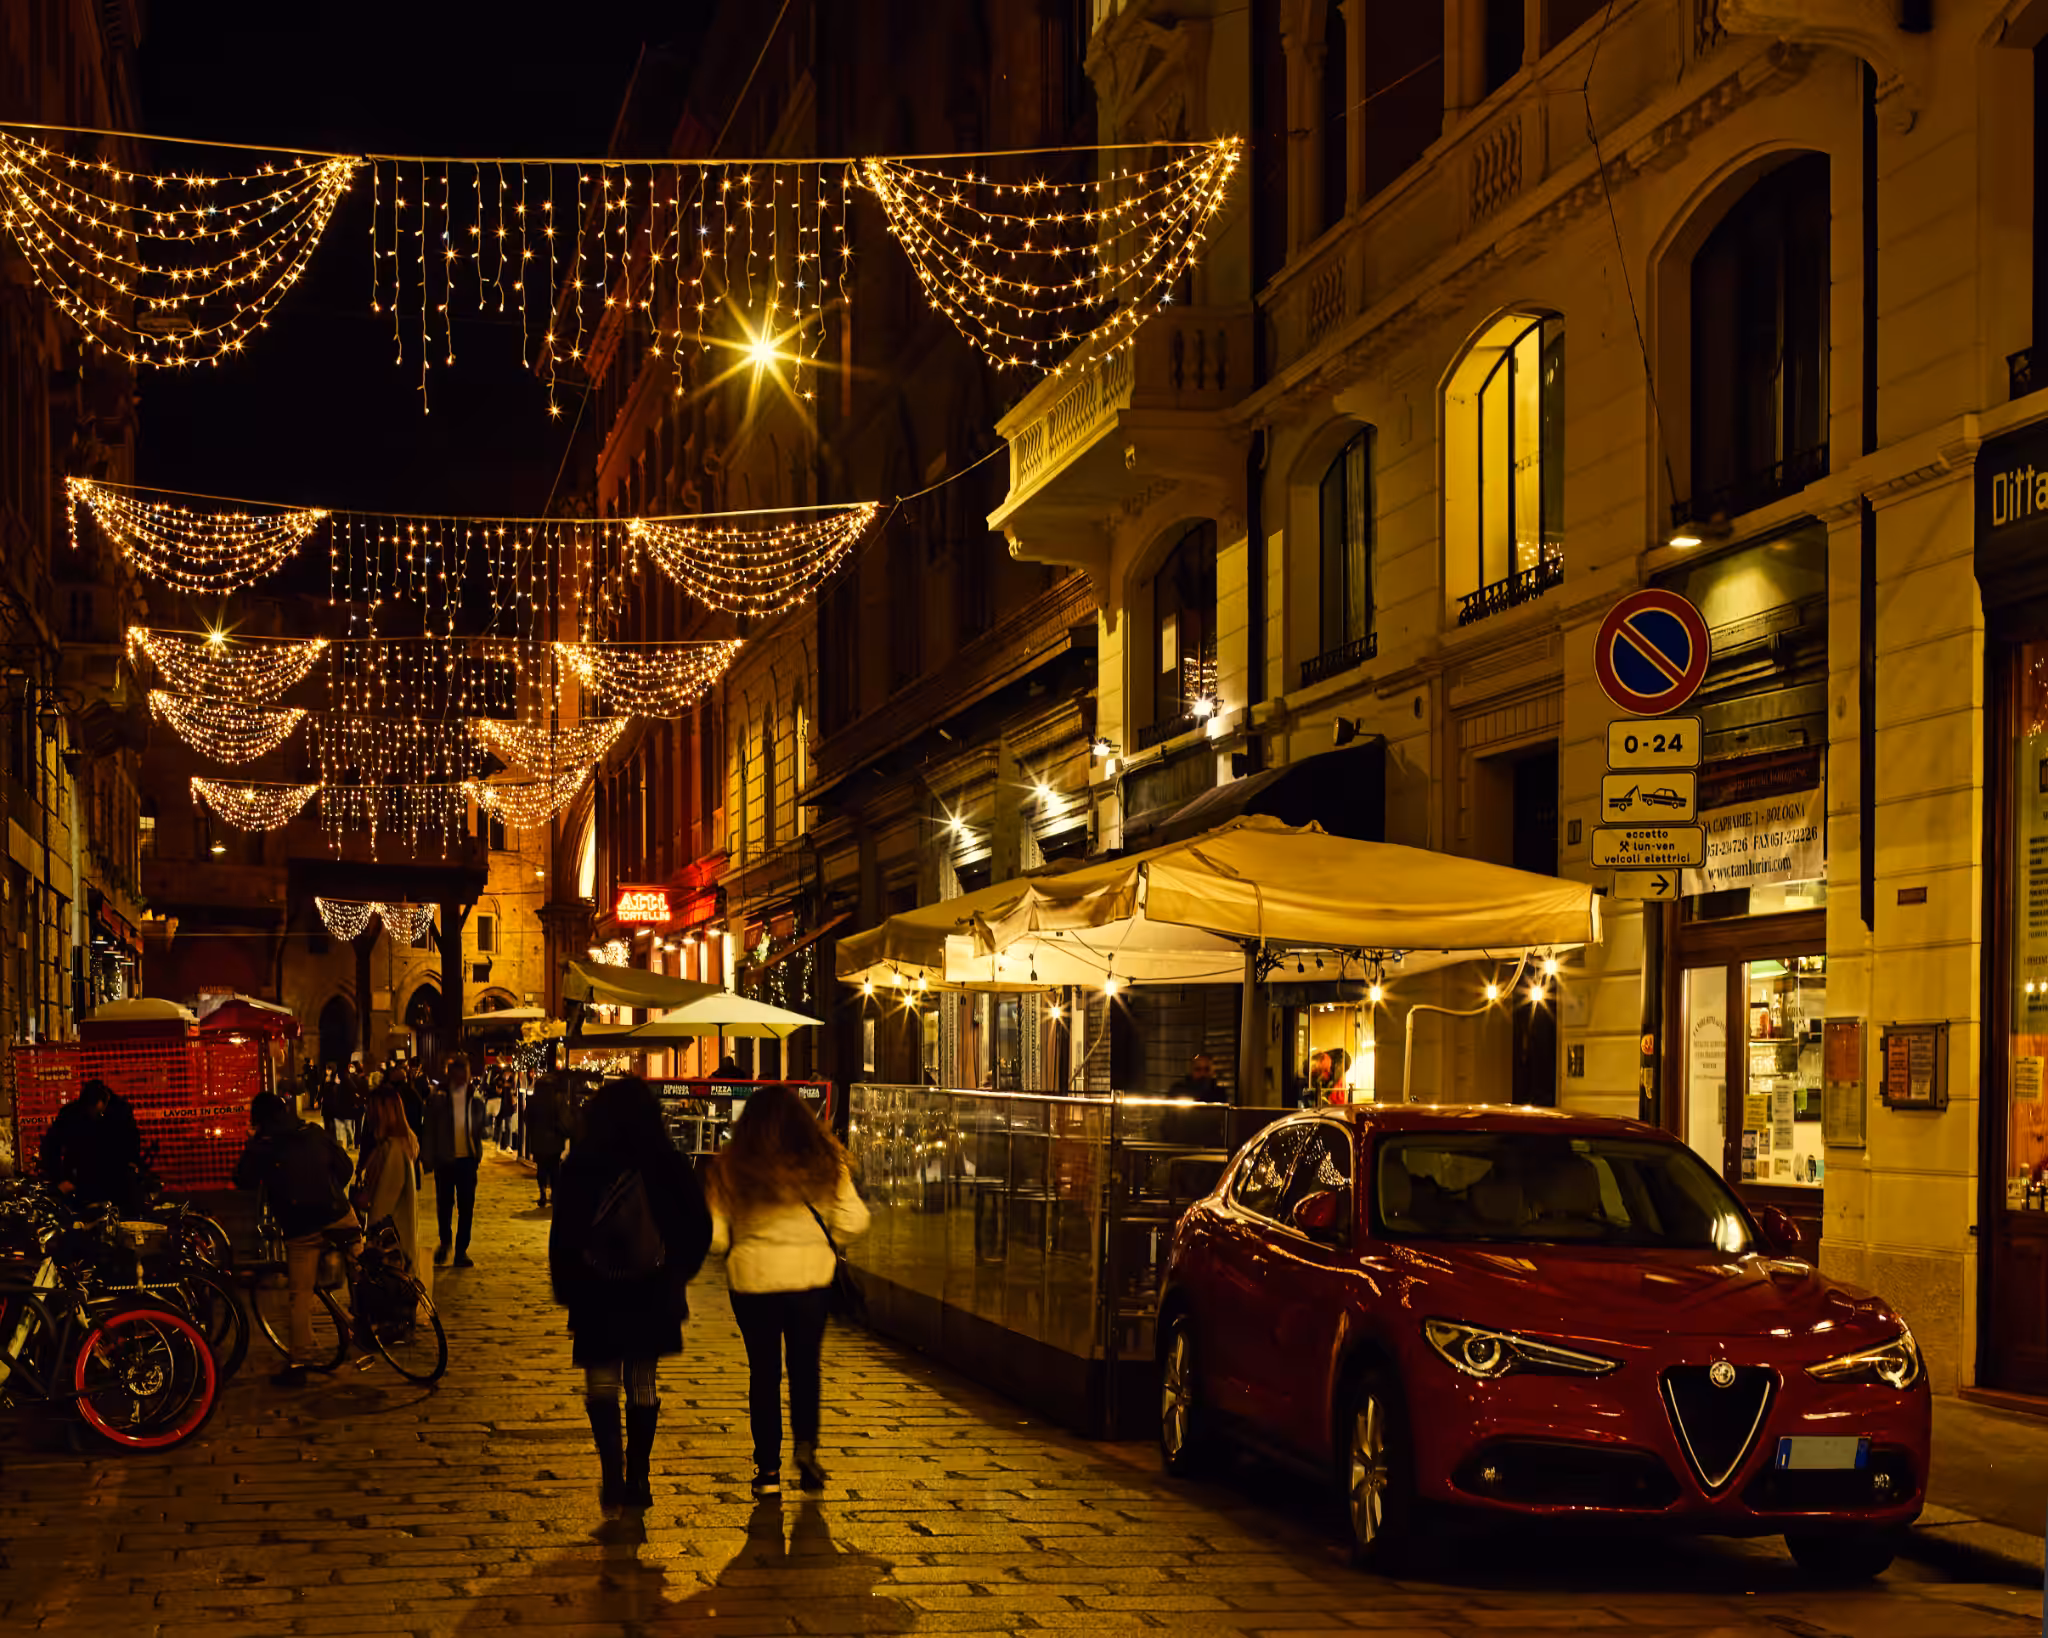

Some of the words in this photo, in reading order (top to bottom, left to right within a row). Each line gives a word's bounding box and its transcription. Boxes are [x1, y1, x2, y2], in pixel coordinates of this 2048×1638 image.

[1993, 464, 2048, 527] Ditta
[1766, 802, 1805, 822] BOLOGNA
[1626, 830, 1669, 839] eccetto
[1604, 853, 1640, 864] veicoli
[1644, 852, 1691, 863] elettrici
[617, 892, 669, 910] Atti
[164, 1109, 197, 1117] LAVORI
